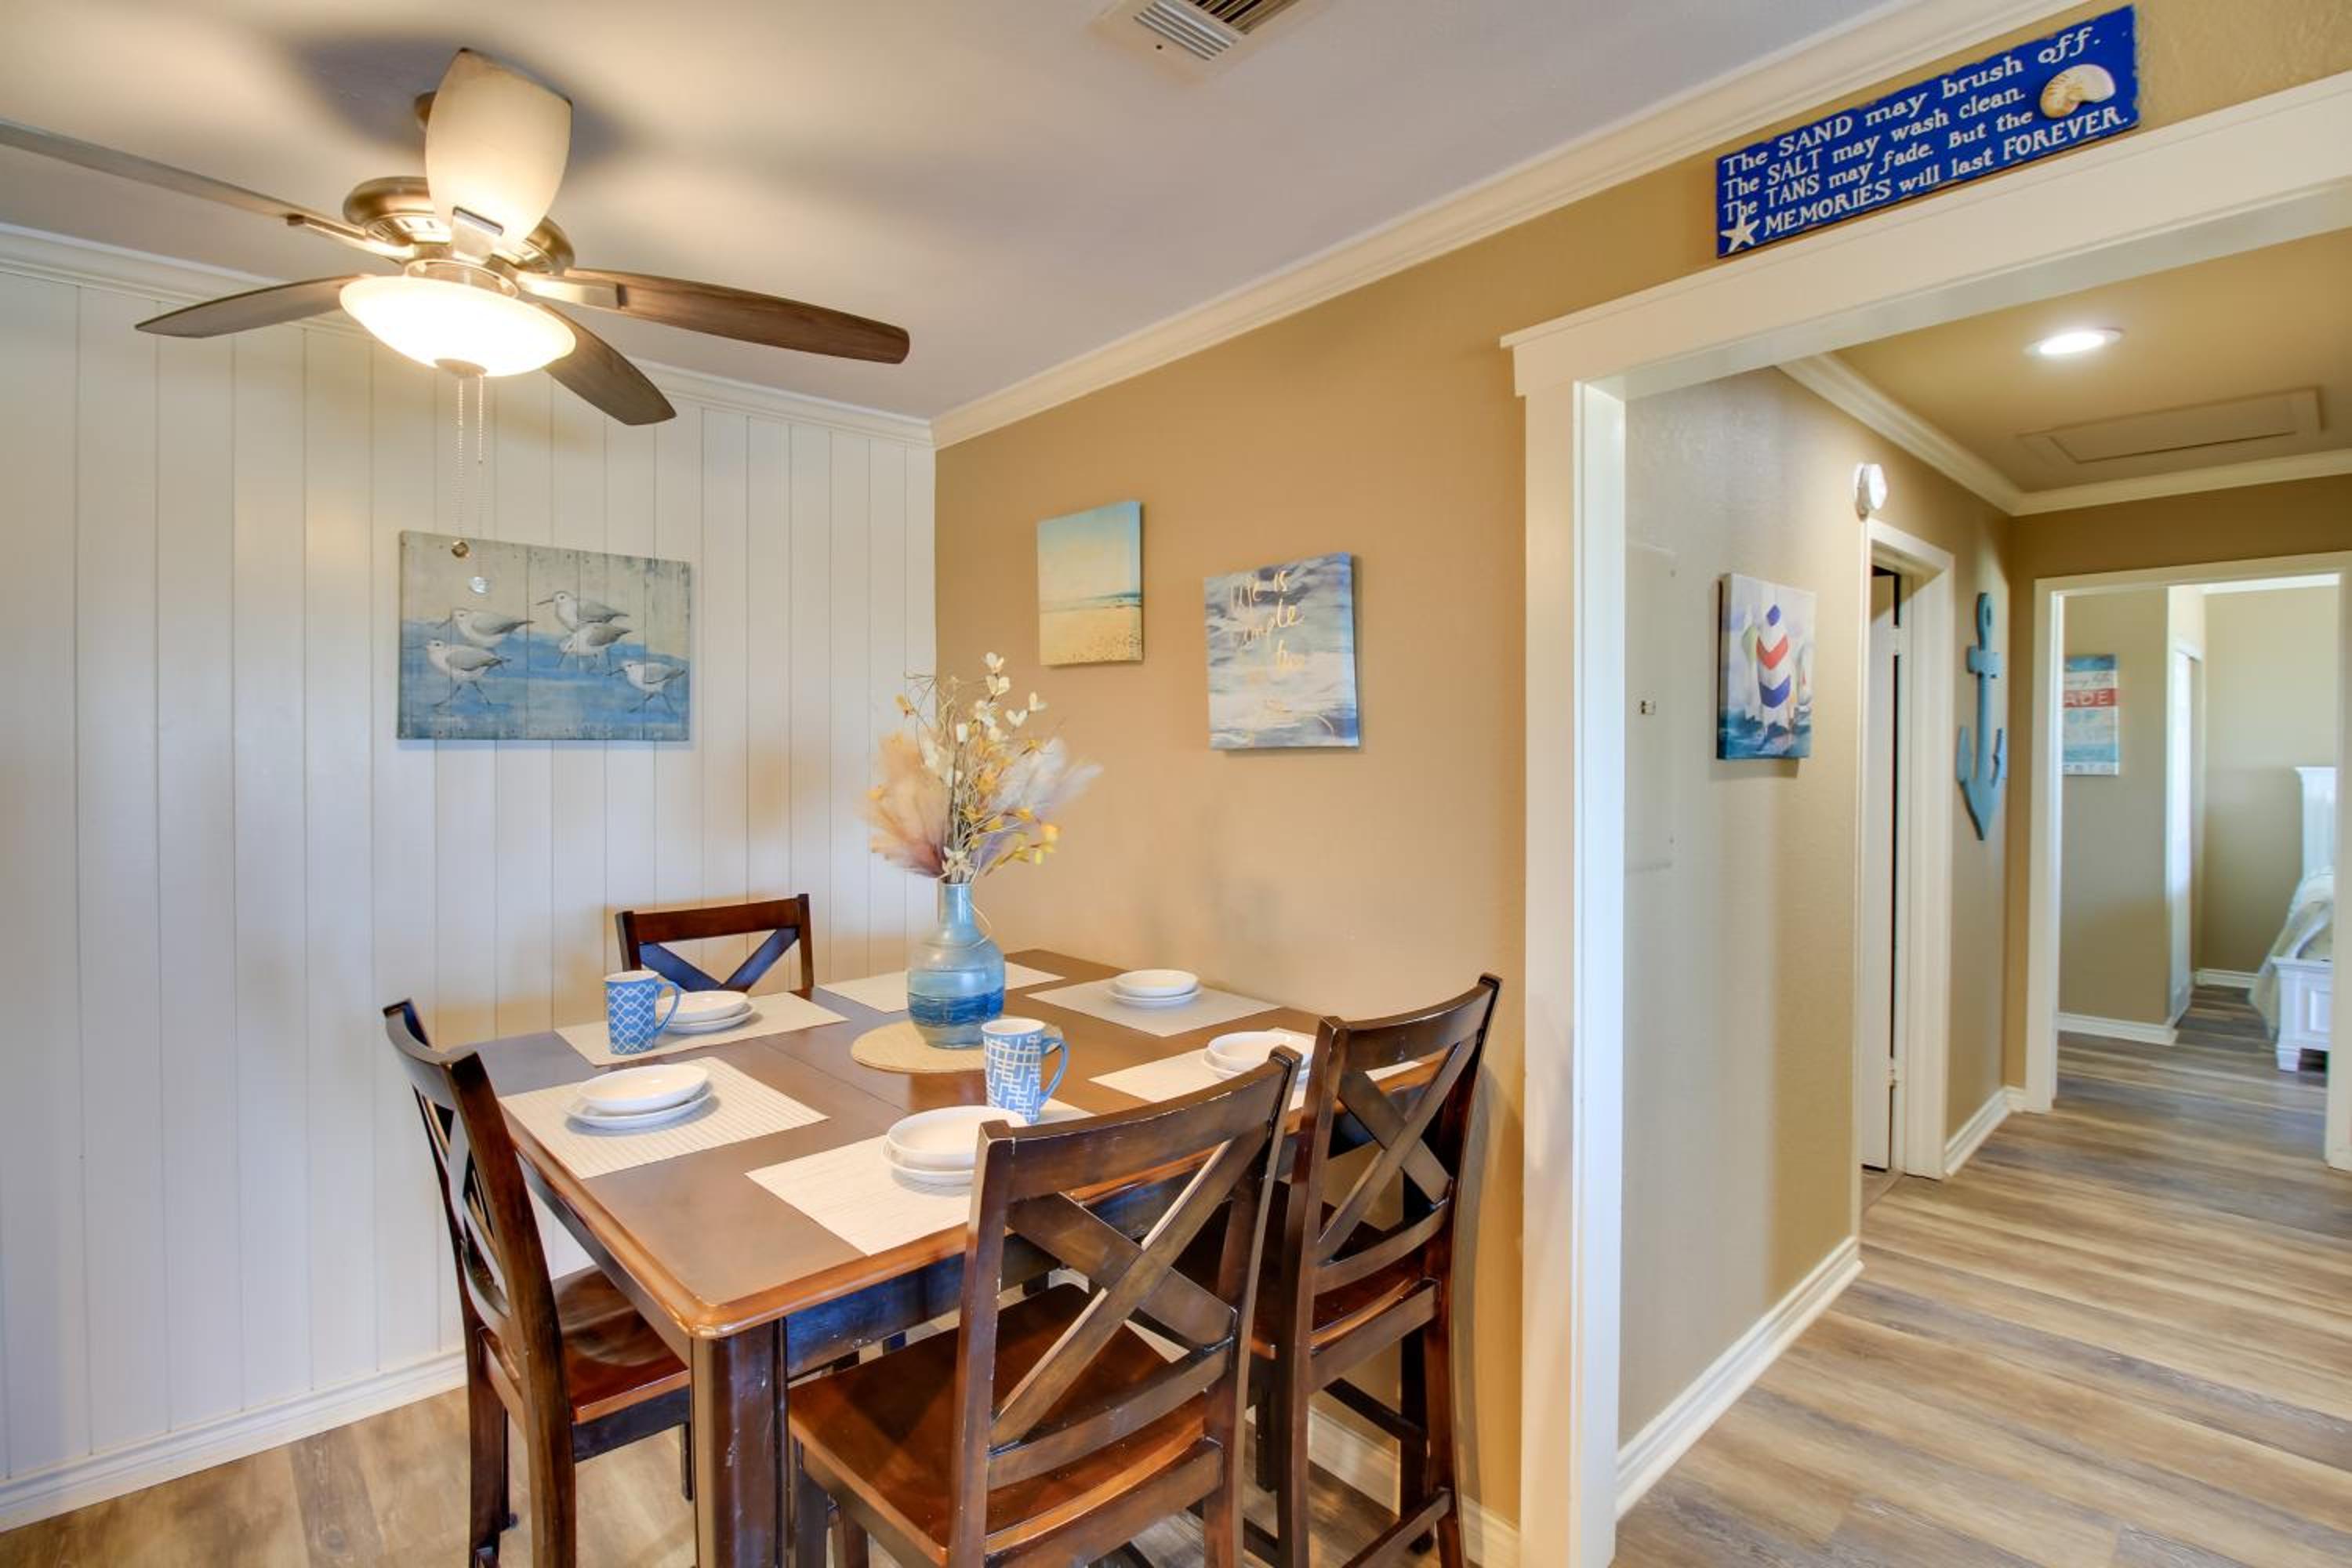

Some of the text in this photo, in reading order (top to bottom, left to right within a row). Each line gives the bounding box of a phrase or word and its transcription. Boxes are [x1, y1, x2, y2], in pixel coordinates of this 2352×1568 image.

[1722, 86, 2027, 200] The SALT may wash clean.
[1723, 27, 2100, 176] The SAND may brush off.
[1722, 111, 2034, 223] The TANS may fade. But the
[1764, 107, 2129, 236] MEMORIES will last FOREVER.
